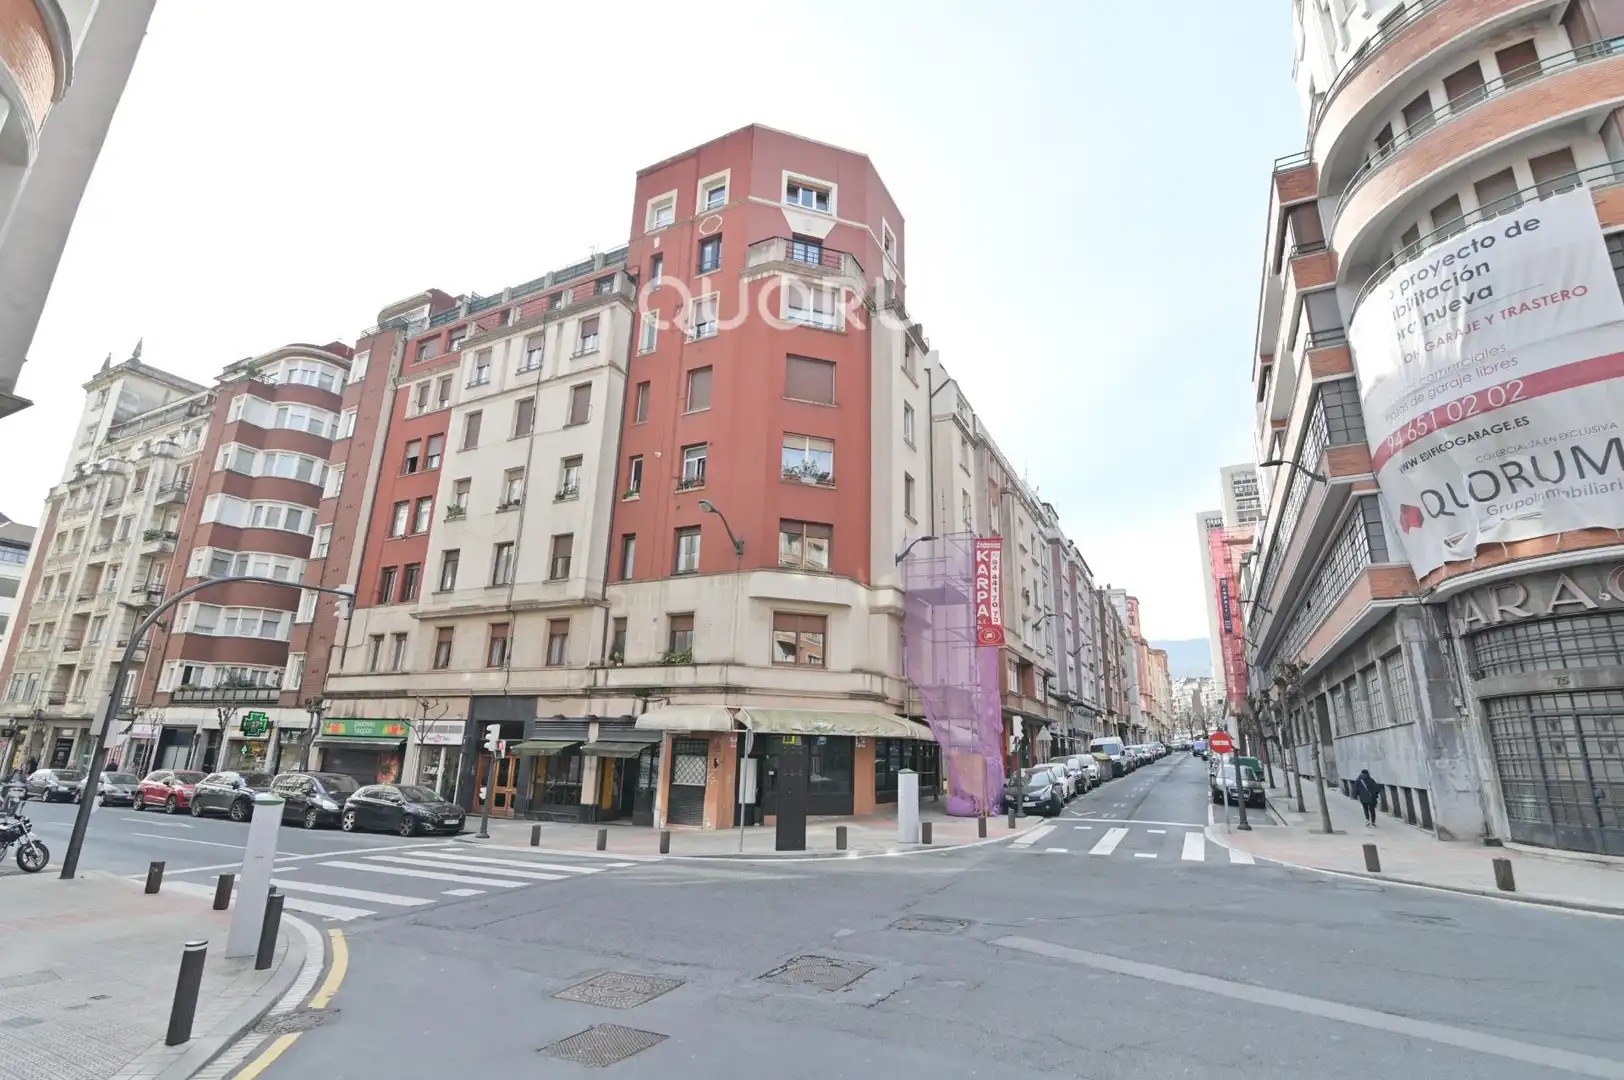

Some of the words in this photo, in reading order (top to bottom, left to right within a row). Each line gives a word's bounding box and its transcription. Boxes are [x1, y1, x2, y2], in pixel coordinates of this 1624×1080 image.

[1400, 235, 1496, 296] proyecto
[1504, 218, 1541, 239] de
[1423, 284, 1494, 326] nueva
[1424, 319, 1481, 352] GARAJE
[1484, 314, 1495, 326] Y
[1500, 285, 1589, 321] TRASTERO
[1411, 393, 1425, 407] de
[1428, 373, 1472, 399] garaje
[1475, 356, 1519, 378] libres
[1420, 344, 1507, 386] comerciales
[1387, 430, 1403, 454] 94
[1407, 410, 1438, 441] 651
[1446, 395, 1480, 421] 02
[1487, 379, 1527, 407] 02
[976, 550, 989, 617] KARPA
